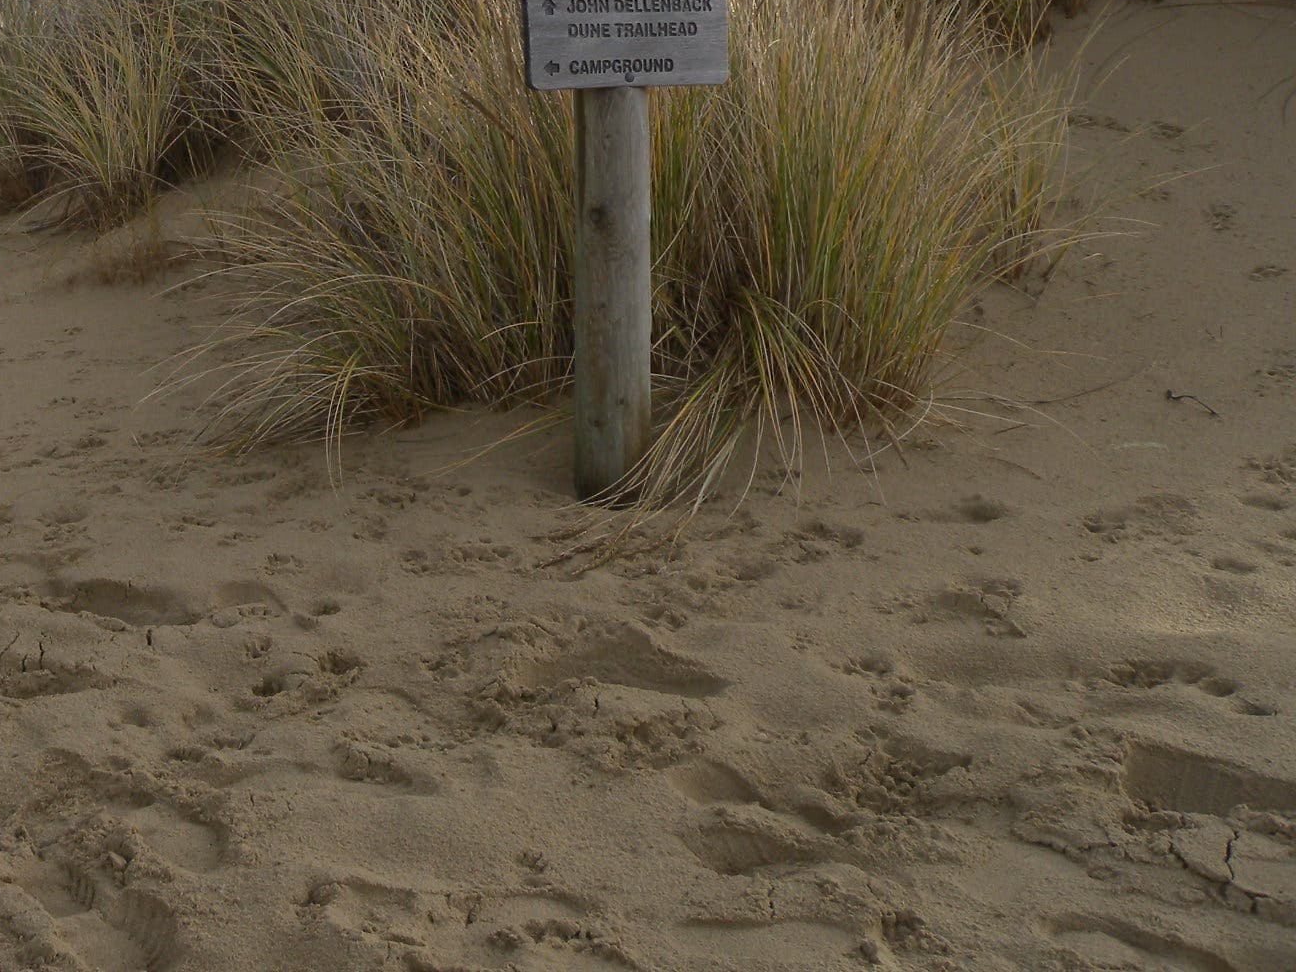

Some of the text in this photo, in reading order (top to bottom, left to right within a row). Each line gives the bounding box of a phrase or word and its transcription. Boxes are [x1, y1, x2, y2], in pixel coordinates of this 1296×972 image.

[567, 21, 698, 38] DUNE TRAILHEAD
[569, 58, 674, 75] CAMPGROUND
